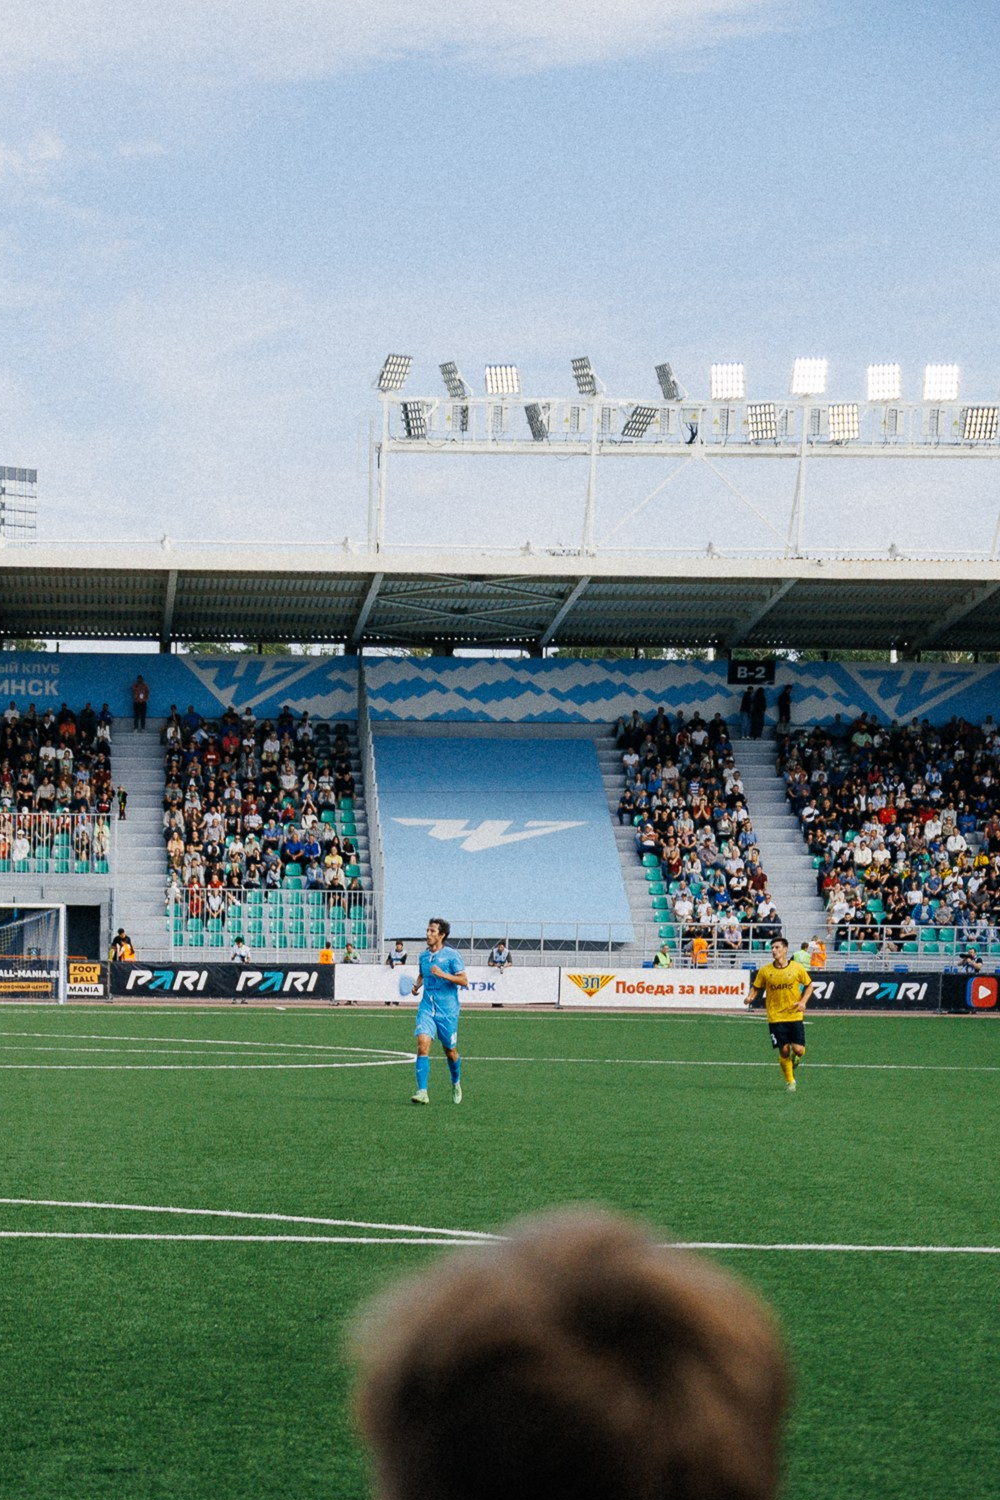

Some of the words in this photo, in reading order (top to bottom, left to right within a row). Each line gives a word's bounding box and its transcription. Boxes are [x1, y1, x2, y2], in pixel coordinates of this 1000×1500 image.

[22, 663, 60, 674] КЛУБ
[73, 965, 97, 973] FOOT
[73, 975, 95, 983] BALL
[126, 970, 208, 990] PARI
[235, 971, 318, 992] PARI
[615, 980, 674, 996] Победа
[678, 984, 695, 995] за
[699, 982, 745, 995] нами!
[855, 982, 928, 1000] PARI
